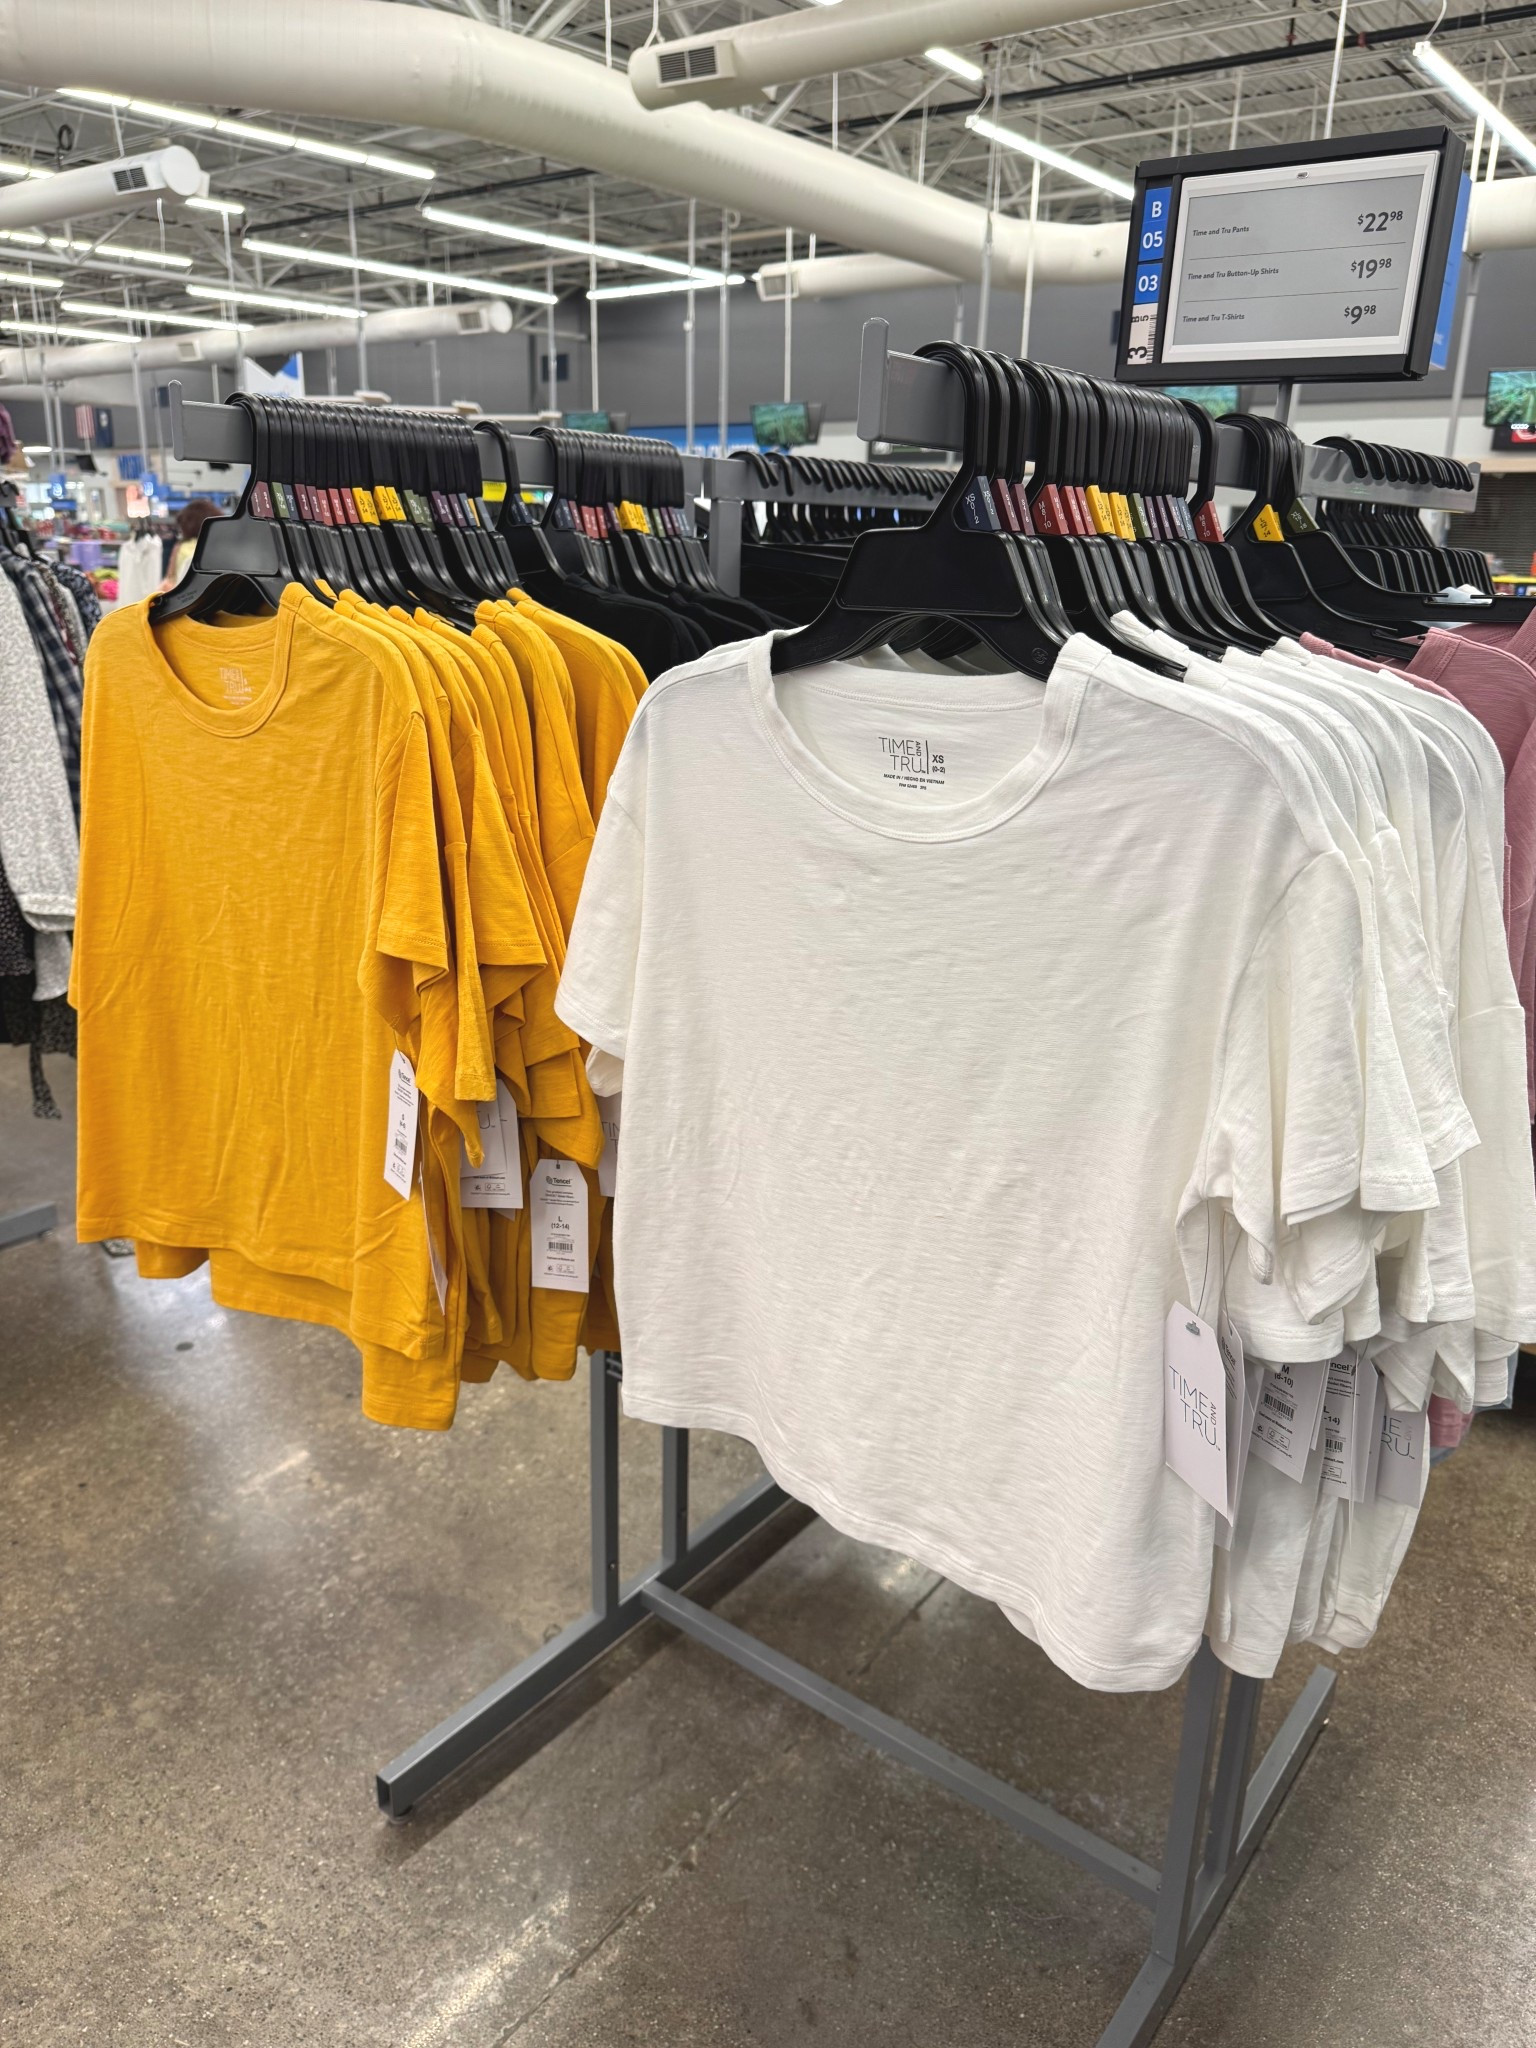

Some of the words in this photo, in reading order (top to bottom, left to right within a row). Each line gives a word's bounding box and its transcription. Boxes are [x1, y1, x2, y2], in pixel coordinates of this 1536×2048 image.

[1151, 200, 1163, 218] B
[1142, 230, 1163, 249] 05
[1192, 229, 1207, 237] Time
[1226, 269, 1260, 277] Button-Up
[1138, 274, 1158, 292] 03
[1182, 315, 1197, 323] Time
[1221, 313, 1245, 321] T-Shirts
[878, 736, 916, 756] TIME
[889, 754, 922, 774] TRU
[932, 754, 945, 764] XS
[1281, 1364, 1290, 1375] M
[1330, 1362, 1350, 1371] ncel
[1169, 1365, 1209, 1419] TIME
[1180, 1398, 1217, 1446] TRU
